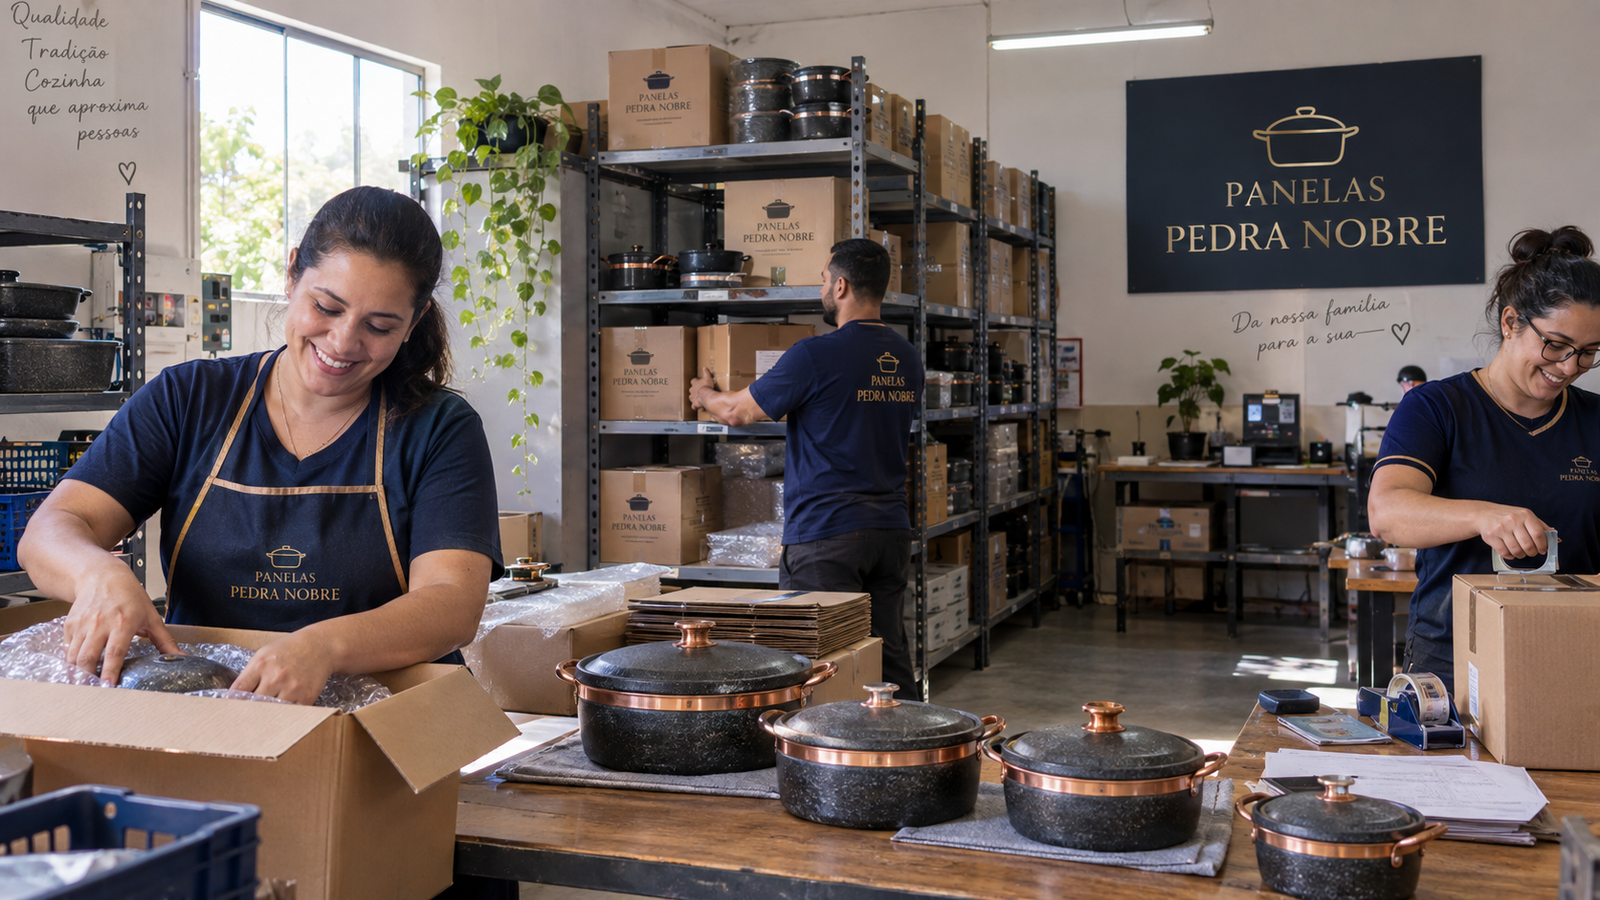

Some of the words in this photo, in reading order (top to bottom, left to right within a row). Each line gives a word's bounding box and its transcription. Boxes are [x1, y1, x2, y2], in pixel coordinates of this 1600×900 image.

[10, 1, 109, 30] Qualidade
[21, 37, 109, 63] Tradição
[25, 68, 105, 92] Cozinha
[639, 92, 679, 101] PANELAS
[27, 103, 60, 125] que
[68, 99, 149, 122] aproxima
[625, 104, 656, 114] PEDRA
[659, 101, 692, 111] NOBRE
[77, 127, 140, 150] pessoas
[1225, 175, 1386, 208] PANELAS
[757, 221, 800, 231] PANELAS
[1166, 221, 1290, 253] PEDRA
[1302, 215, 1448, 250] NOBRE
[743, 234, 776, 243] PEDRA
[779, 232, 815, 242] NOBRE
[1231, 311, 1263, 334] Da
[1270, 309, 1319, 326] nossa
[1256, 338, 1299, 361] para
[1306, 335, 1319, 345] a
[612, 377, 639, 386] PEDRA
[640, 377, 669, 386] NOBRE
[871, 375, 905, 386] PANELAS
[857, 390, 886, 401] PEDRA
[888, 390, 915, 402] NOBRE
[611, 522, 637, 531] PEDRA
[639, 523, 667, 532] NOBRE
[255, 571, 316, 584] PANELAS
[230, 585, 280, 600] PEDRA
[284, 588, 341, 601] NOBRE
